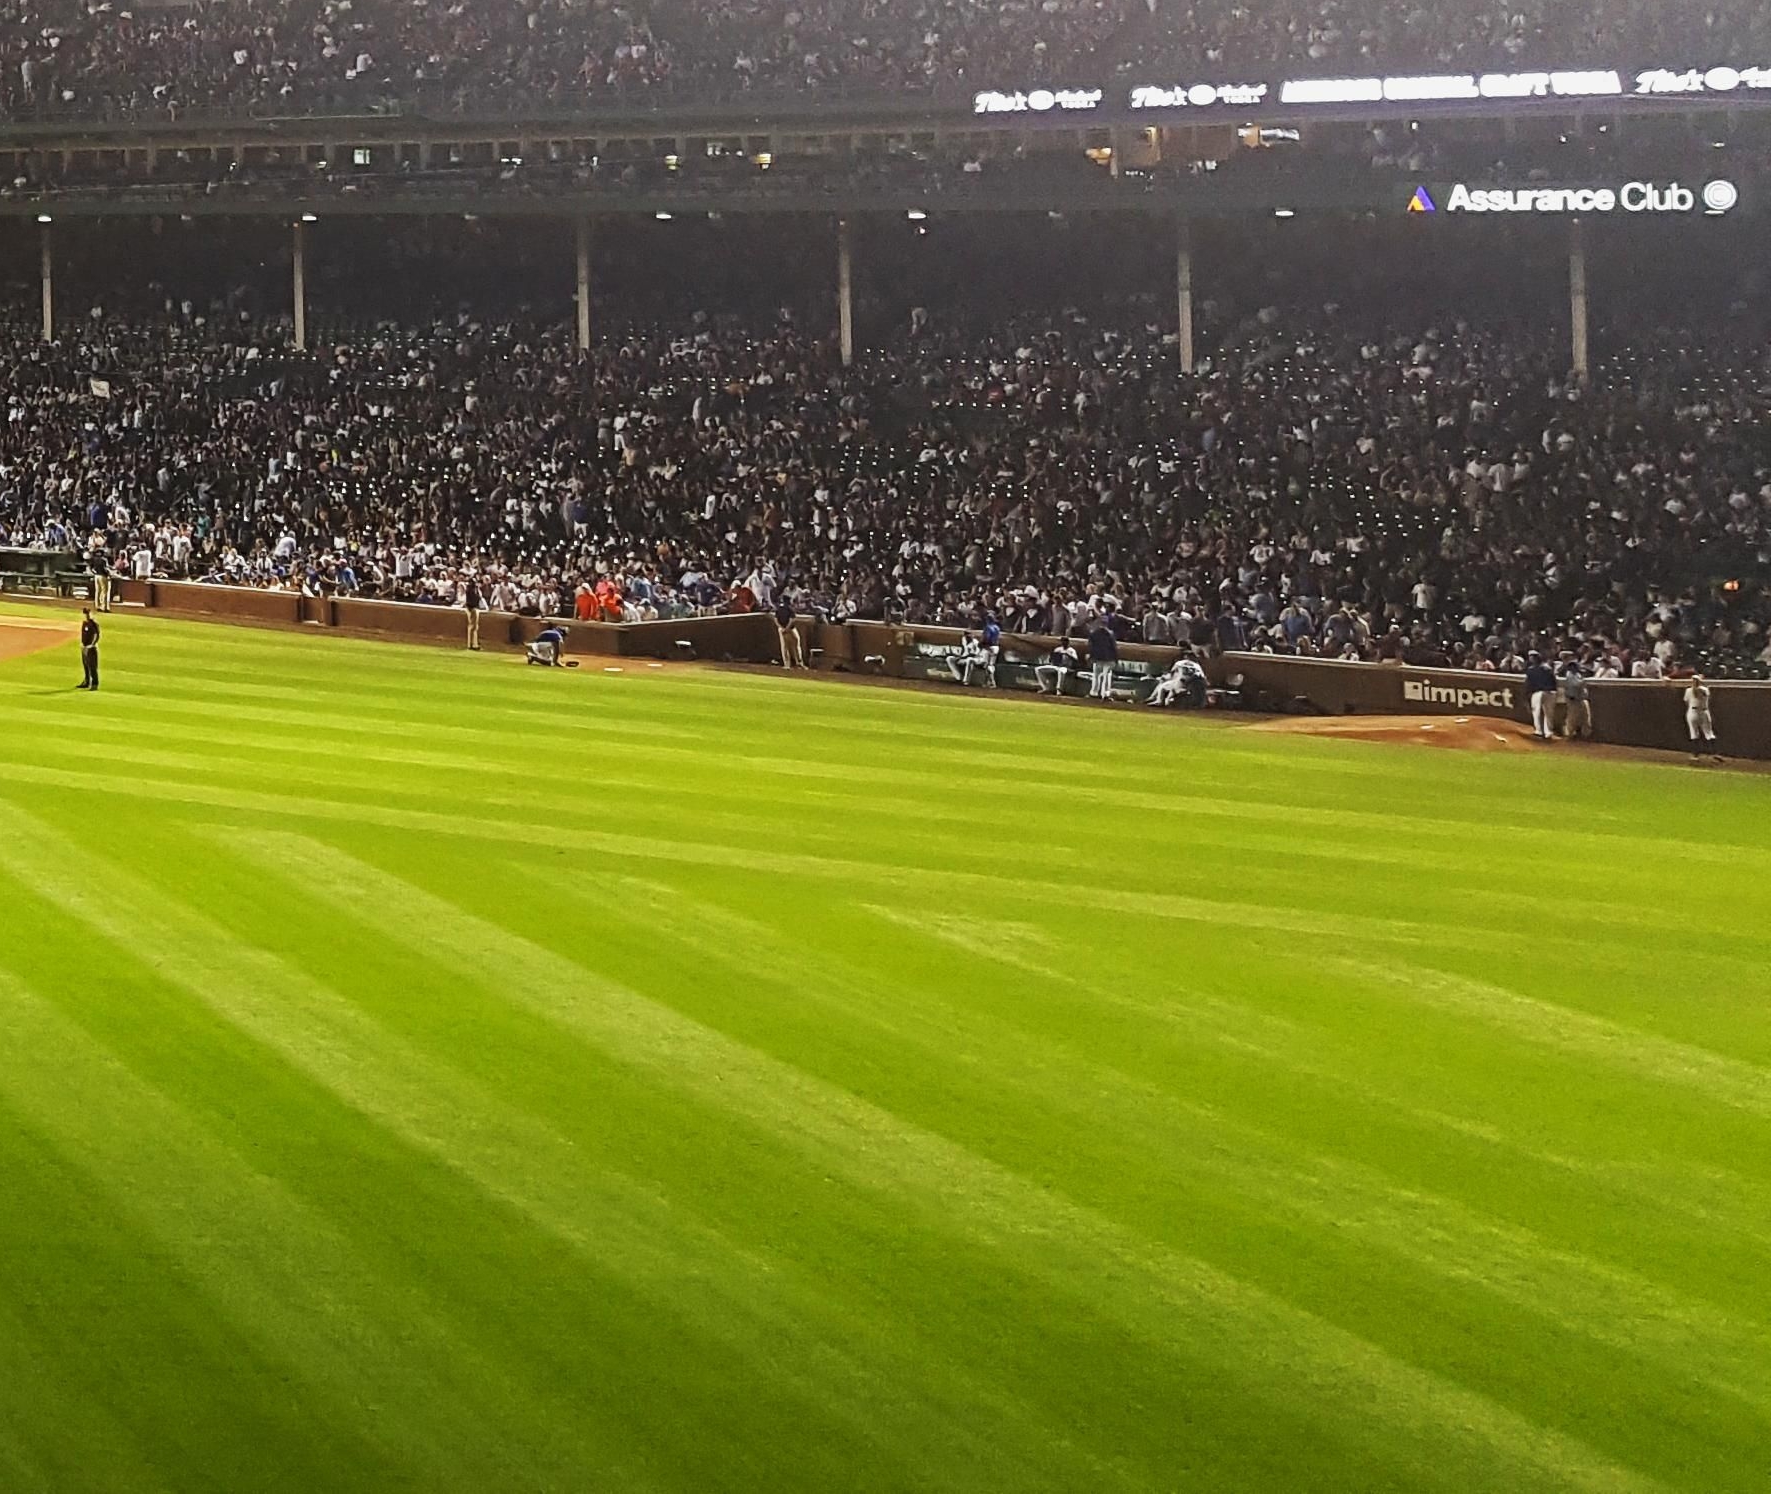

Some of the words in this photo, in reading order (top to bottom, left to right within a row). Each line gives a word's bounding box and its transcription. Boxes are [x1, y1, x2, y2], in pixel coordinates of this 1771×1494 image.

[1446, 183, 1616, 211] Assurance
[1620, 181, 1694, 212] Club
[1423, 679, 1514, 708] impact
